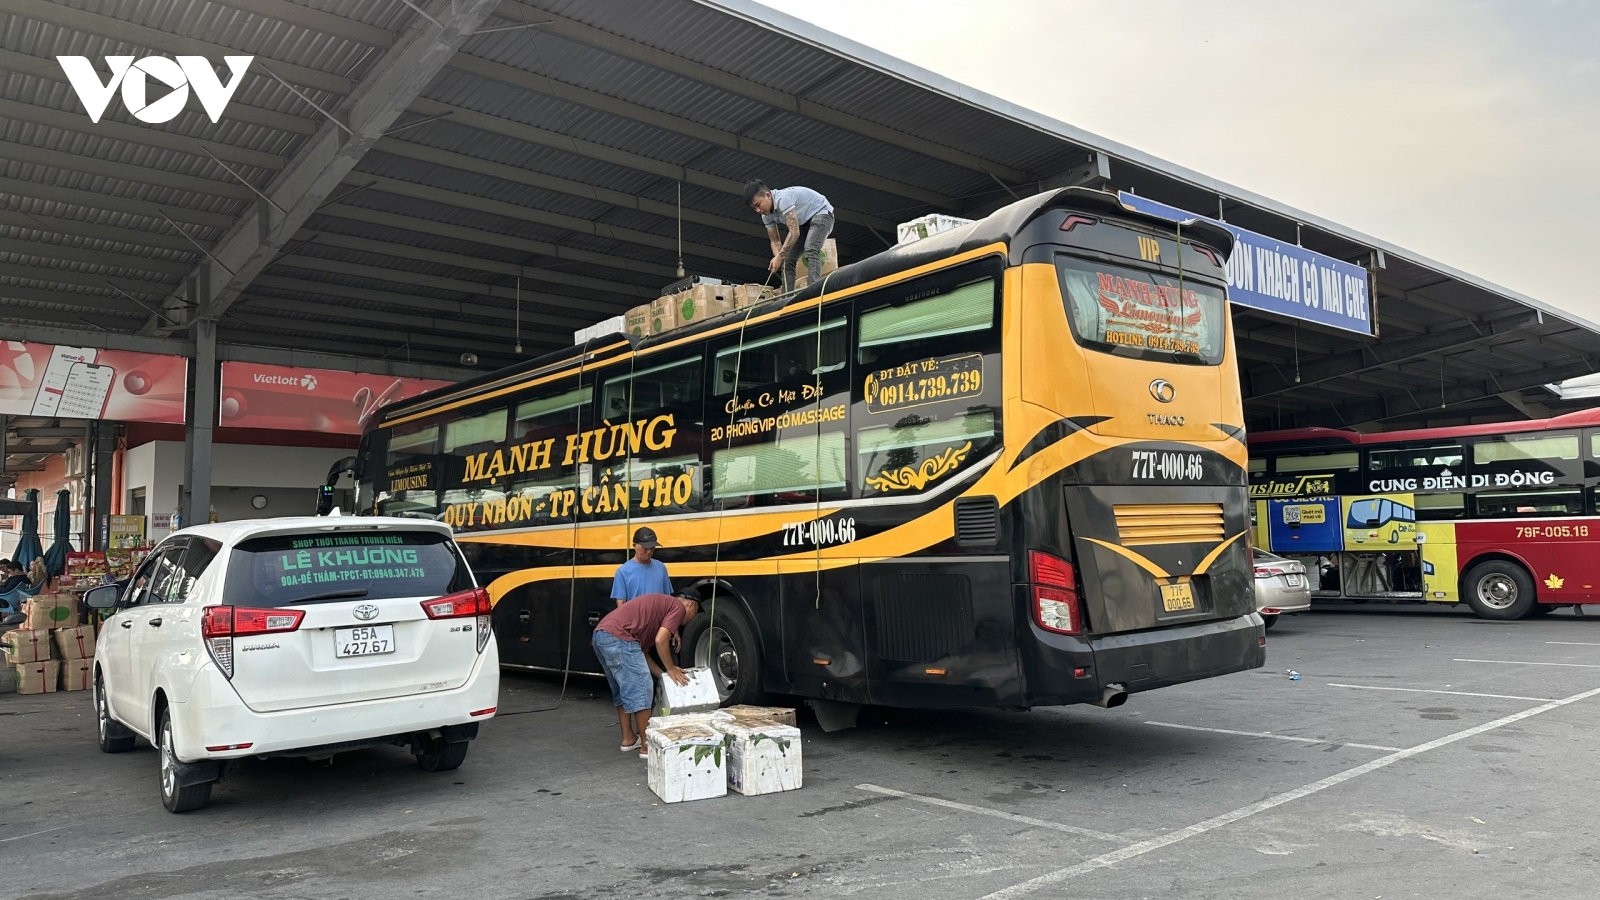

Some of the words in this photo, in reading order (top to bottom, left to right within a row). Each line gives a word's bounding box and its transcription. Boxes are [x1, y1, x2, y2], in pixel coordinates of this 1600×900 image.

[1137, 236, 1160, 262] VIP
[1256, 245, 1300, 303] KHÁCH
[1302, 257, 1319, 309] CÓ
[1320, 263, 1343, 315] MÁI
[1344, 274, 1366, 320] CHE
[1154, 281, 1199, 308] HÙNG
[253, 373, 298, 386] Vietlott
[880, 368, 894, 380] ĐT
[896, 362, 918, 378] ĐẶT
[880, 369, 980, 406] 0914.739.739
[711, 427, 723, 441] 20
[759, 417, 776, 432] VIP
[776, 410, 790, 429] CÓ
[791, 404, 846, 427] MASSAGE
[1147, 412, 1186, 426] THACO
[462, 438, 555, 485] MẠNH
[561, 413, 677, 466] HÙNG
[1131, 450, 1203, 480] 77F-000.66
[391, 474, 428, 492] LIMOUSINE
[638, 467, 694, 508] THƠ
[1369, 478, 1417, 493] CUNG
[1471, 474, 1490, 487] DI
[1494, 469, 1554, 488] ĐỘNG
[292, 539, 314, 549] SHOP
[334, 537, 359, 546] TRANG
[360, 536, 384, 545] TRUNG
[782, 517, 856, 546] 77F-000.66
[1515, 525, 1589, 538] 79F-005.18
[282, 549, 312, 570] LÊ
[318, 547, 418, 567] KHƯƠNG
[1169, 585, 1183, 597] 77F
[242, 642, 280, 651] INNOVA
[352, 629, 377, 641] 65A
[343, 640, 388, 655] 427.67
